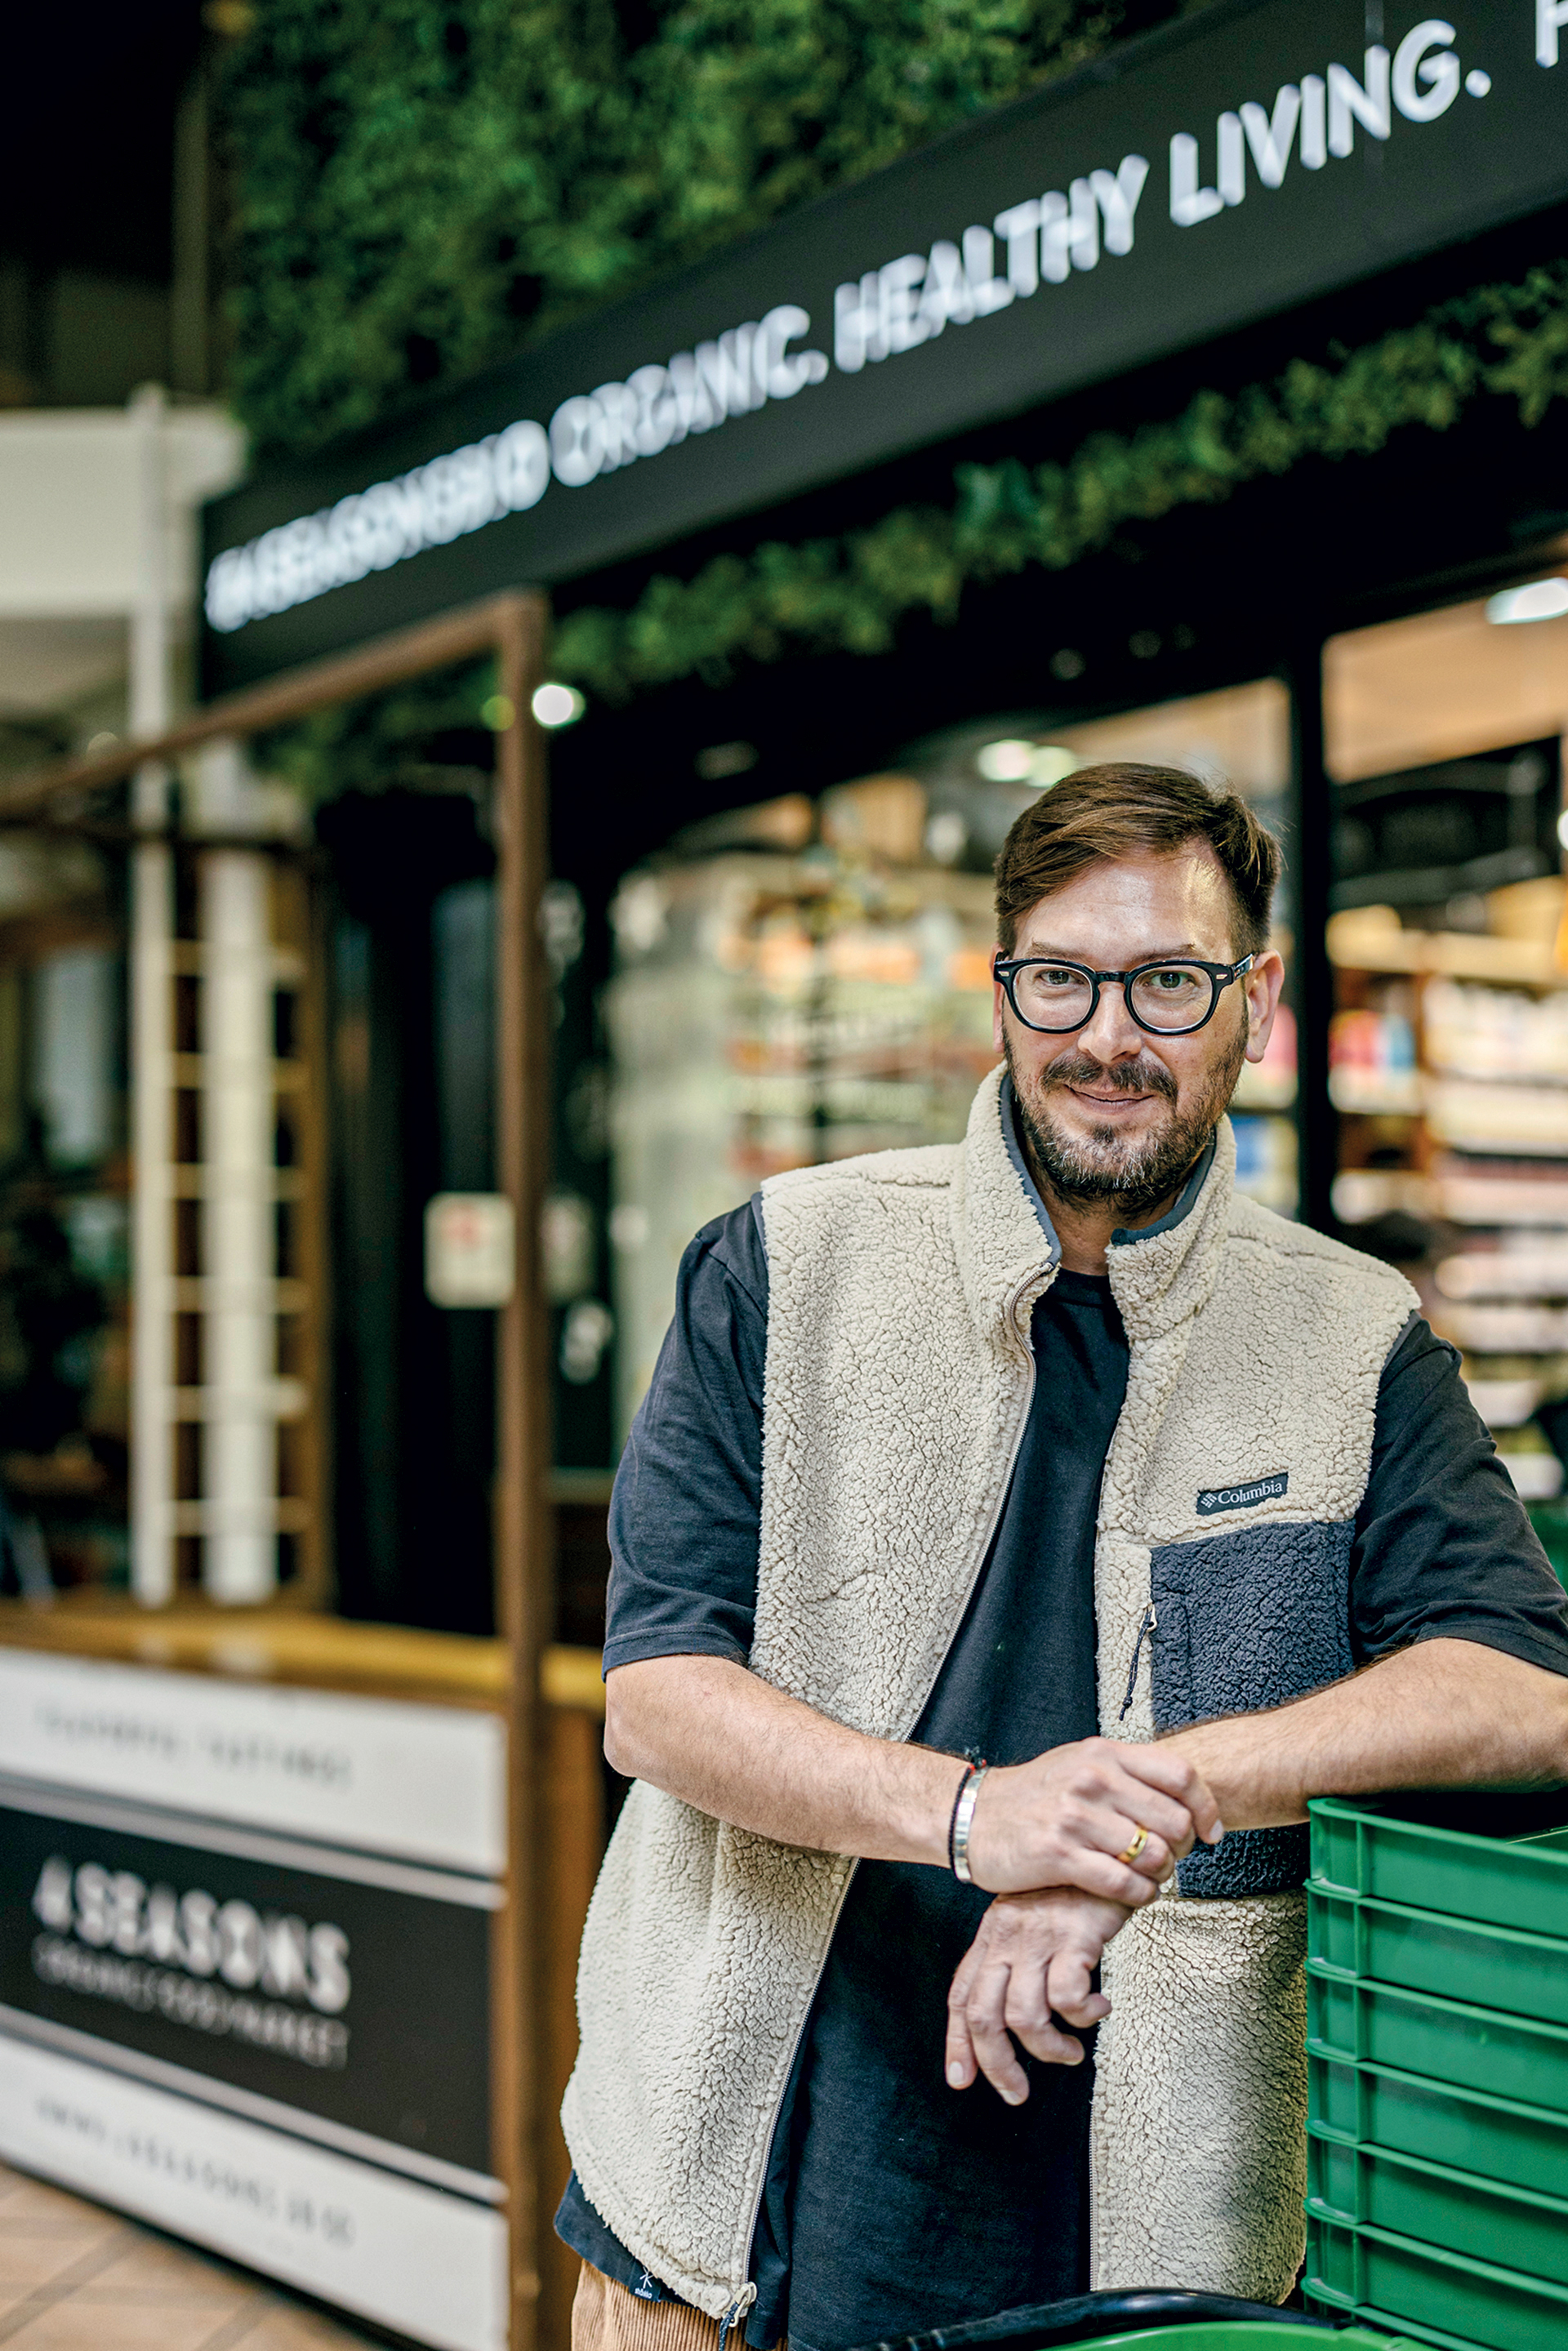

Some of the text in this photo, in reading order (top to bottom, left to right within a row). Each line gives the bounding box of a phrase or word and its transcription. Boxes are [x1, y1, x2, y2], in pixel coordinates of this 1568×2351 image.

[835, 154, 1148, 373] HEALTHY
[1169, 19, 1492, 227] LIVING.
[1218, 1481, 1283, 1505] Columbia
